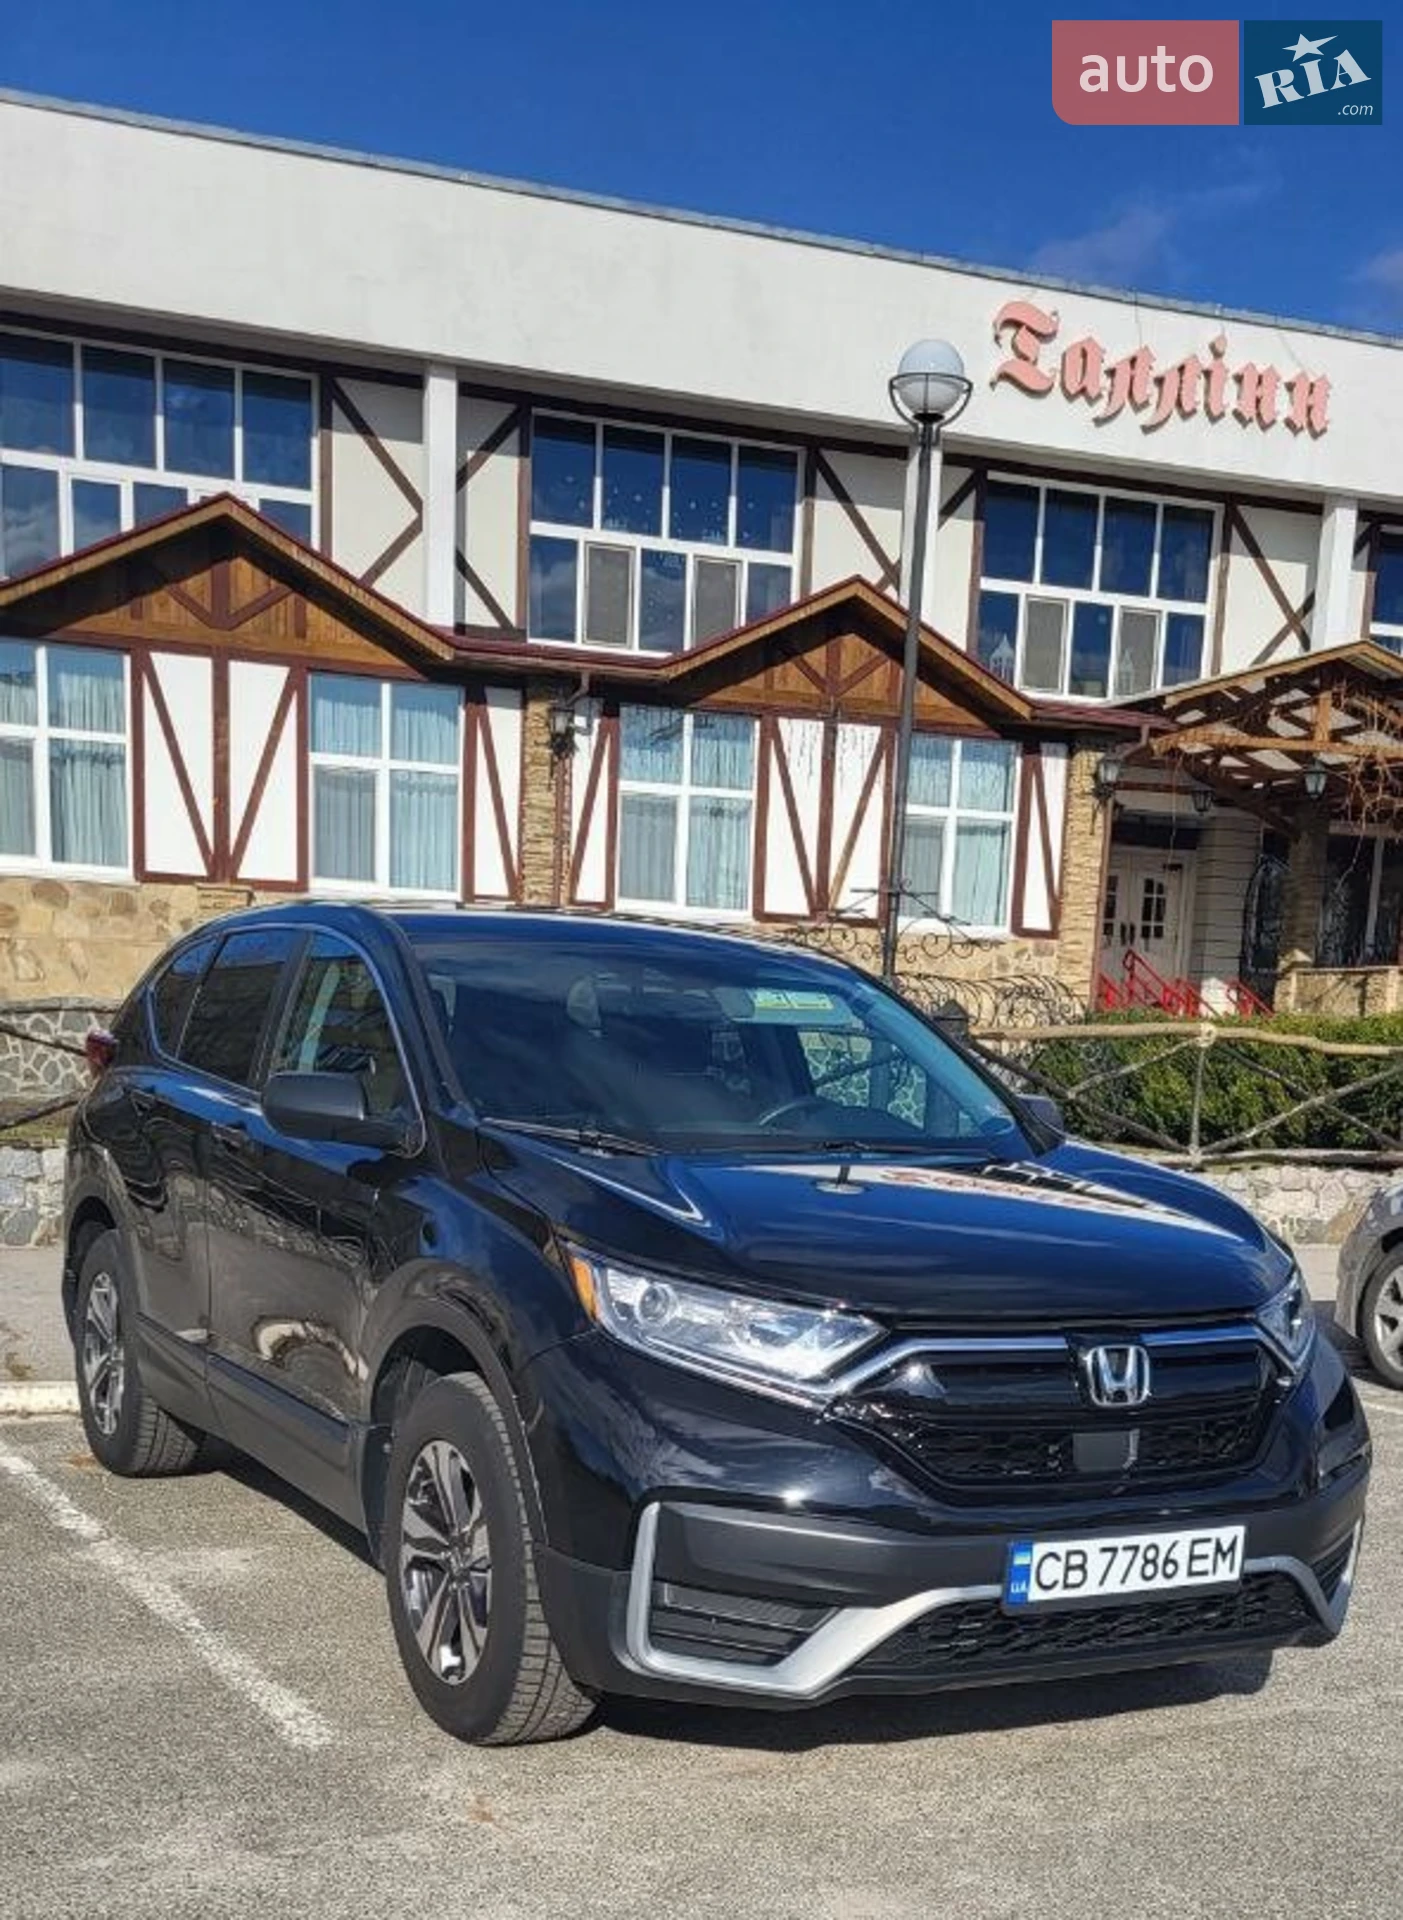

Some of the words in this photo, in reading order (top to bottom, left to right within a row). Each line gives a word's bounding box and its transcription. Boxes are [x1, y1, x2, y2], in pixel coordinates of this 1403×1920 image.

[1035, 1549, 1088, 1590] CB
[1098, 1540, 1179, 1587] 7786
[1187, 1534, 1239, 1577] EM
